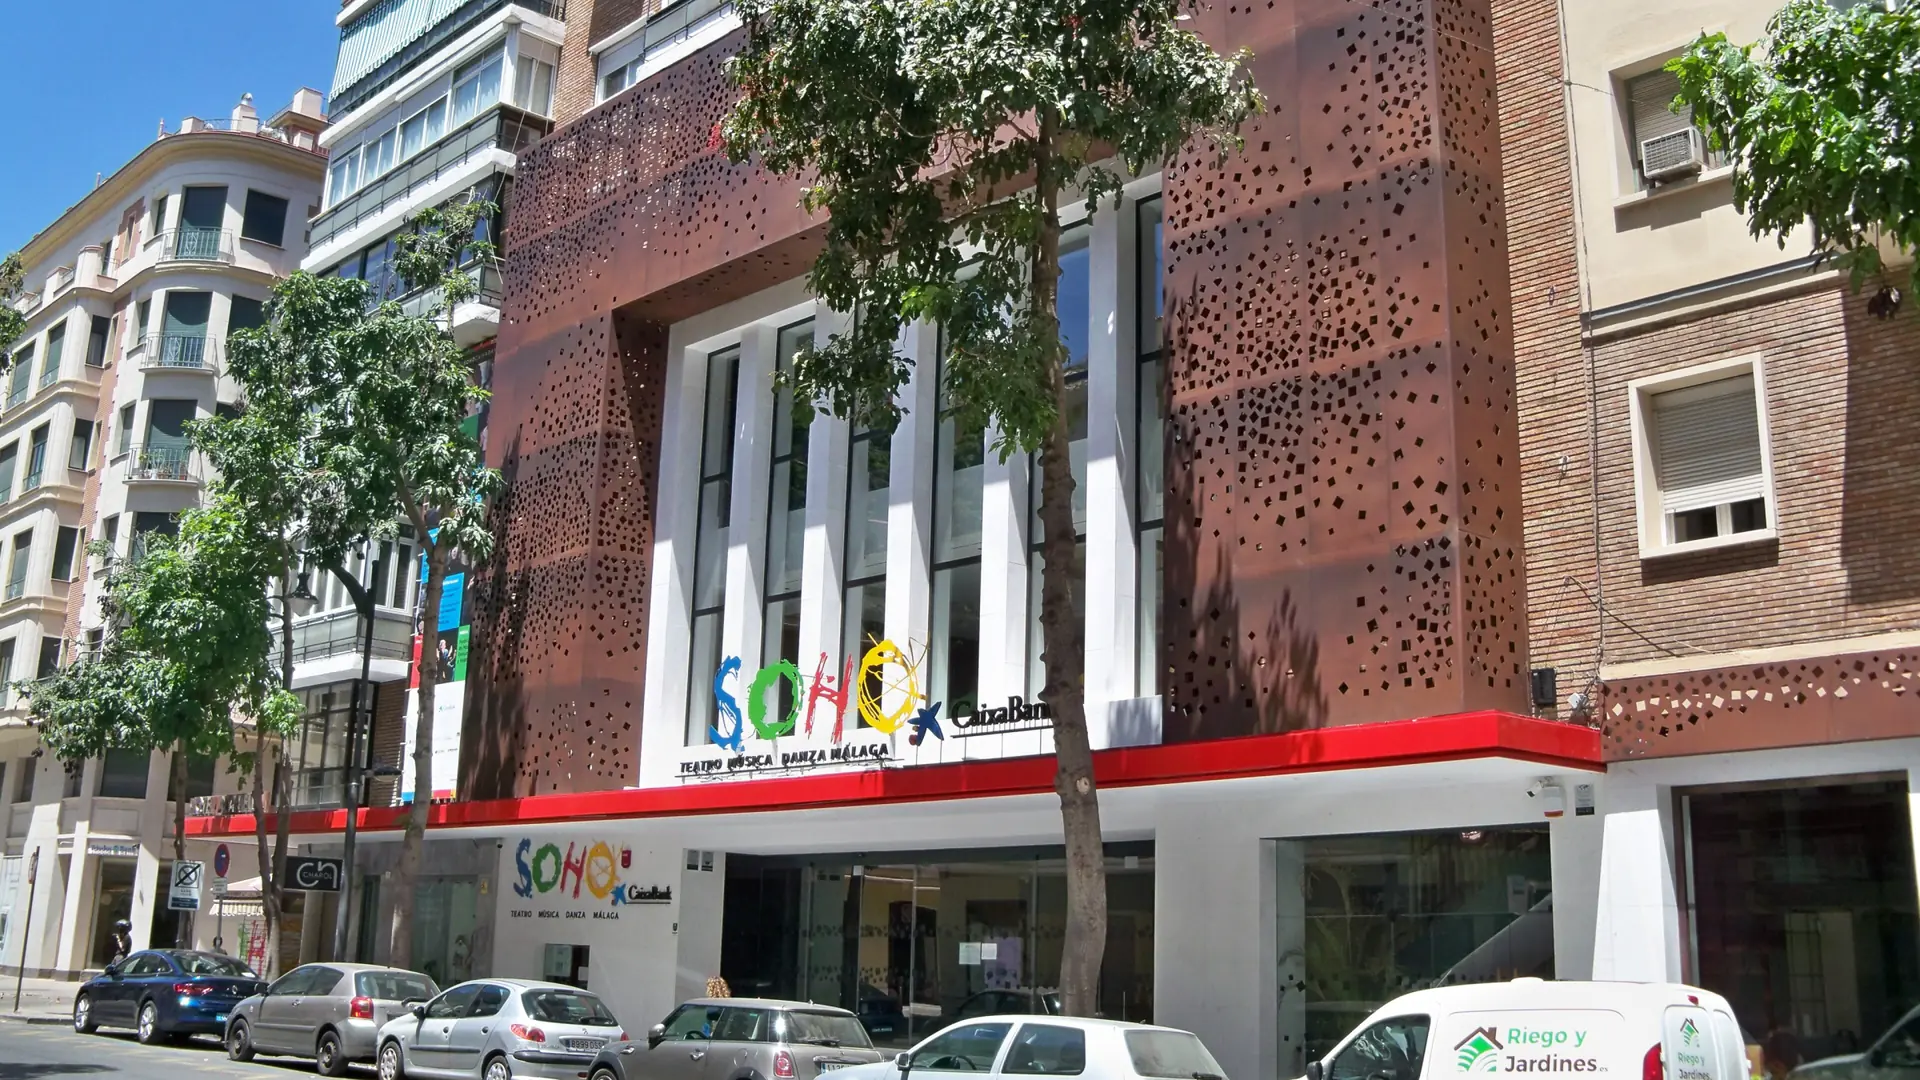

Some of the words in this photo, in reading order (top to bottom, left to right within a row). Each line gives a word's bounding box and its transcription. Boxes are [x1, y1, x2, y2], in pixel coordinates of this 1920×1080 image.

[709, 633, 928, 752] SOHO
[951, 695, 1052, 728] CaixaBan
[680, 757, 723, 773] TEATRO
[727, 752, 774, 770] MÚSICA
[781, 749, 827, 766] DANZA
[830, 742, 889, 761] MÁLAGA
[513, 838, 621, 899] SOHO
[628, 885, 672, 900] CaixaBank
[511, 910, 532, 918] TEATRO
[538, 909, 560, 918] MÚSICA
[565, 911, 586, 919] DANZA
[593, 910, 619, 920] MÁLAGA
[1507, 1026, 1568, 1048] Riego
[1574, 1030, 1587, 1048] y
[1504, 1053, 1597, 1072] Jardines
[1678, 1051, 1699, 1066] Riego
[1679, 1068, 1711, 1080] Jardines
